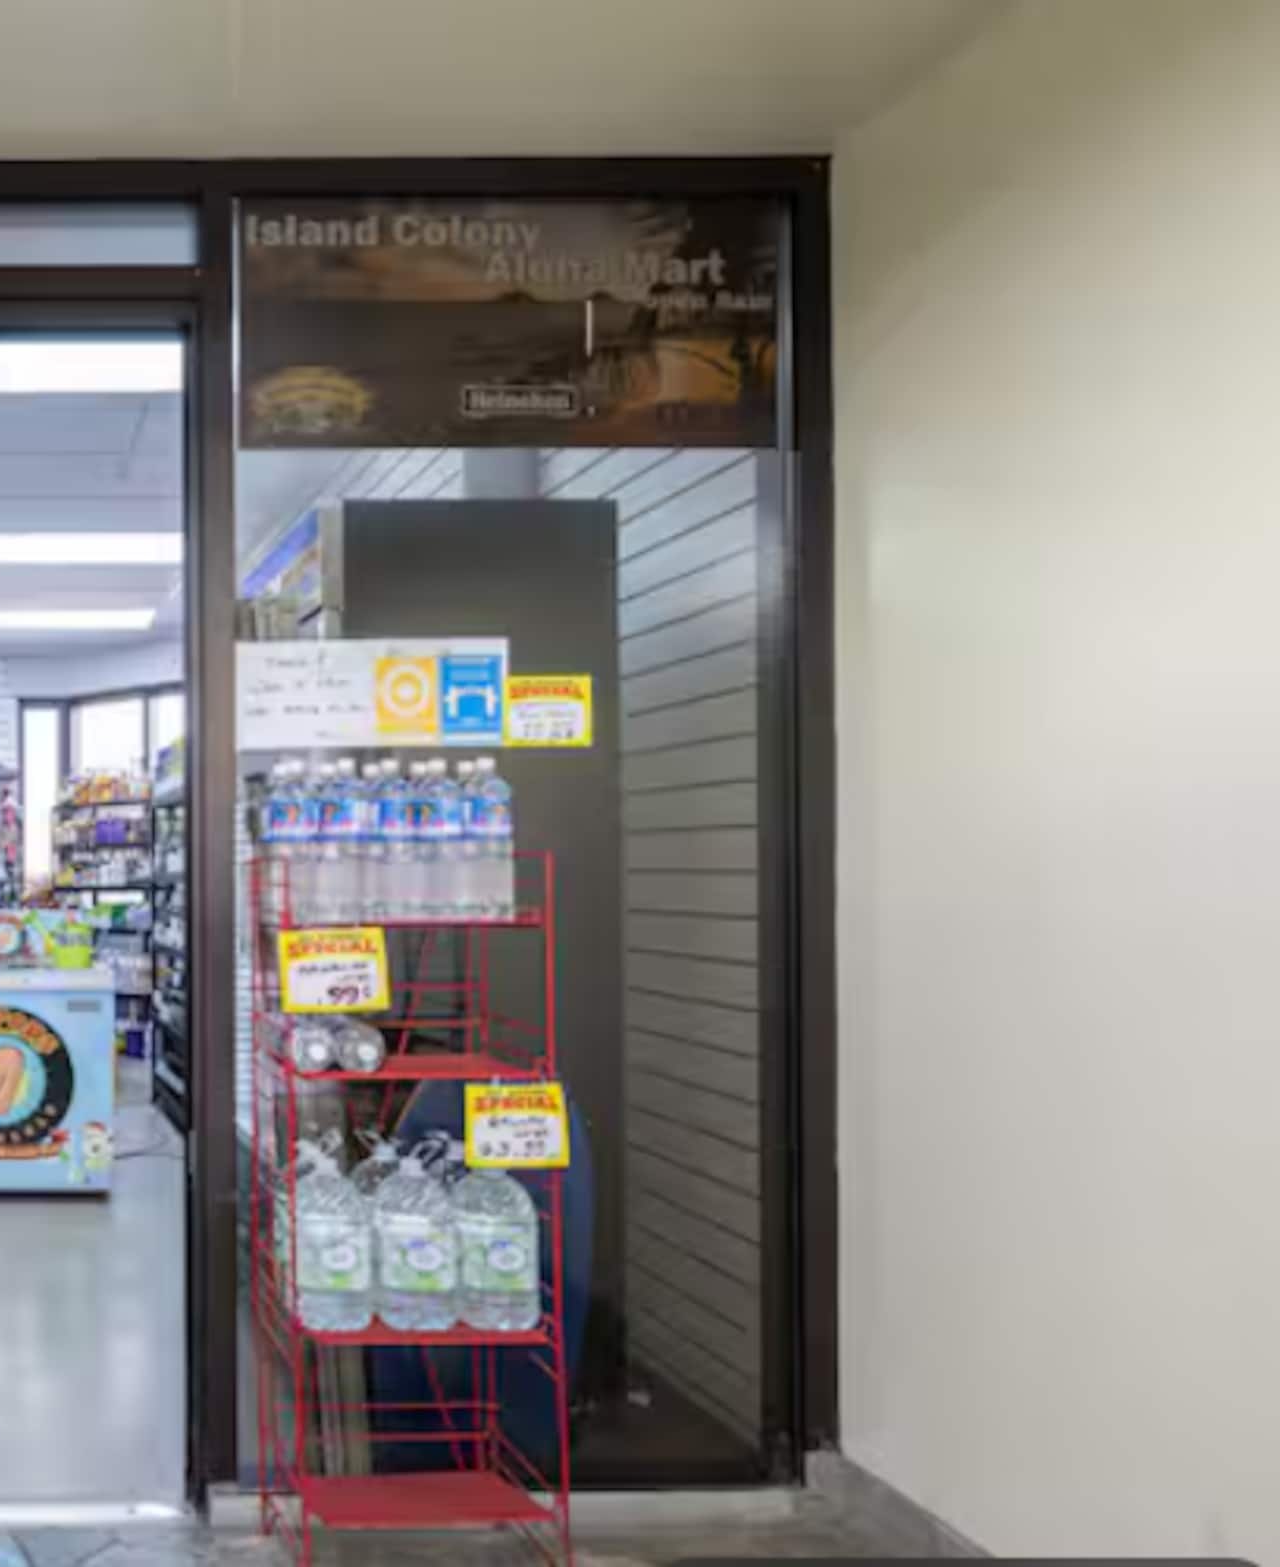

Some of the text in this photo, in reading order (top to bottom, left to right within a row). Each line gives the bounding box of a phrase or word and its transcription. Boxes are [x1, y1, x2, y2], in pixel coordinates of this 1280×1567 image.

[246, 213, 542, 252] Island Colony
[621, 248, 726, 285] Mart
[287, 938, 377, 958] SPECIAL
[475, 1095, 559, 1113] SPECIAL
